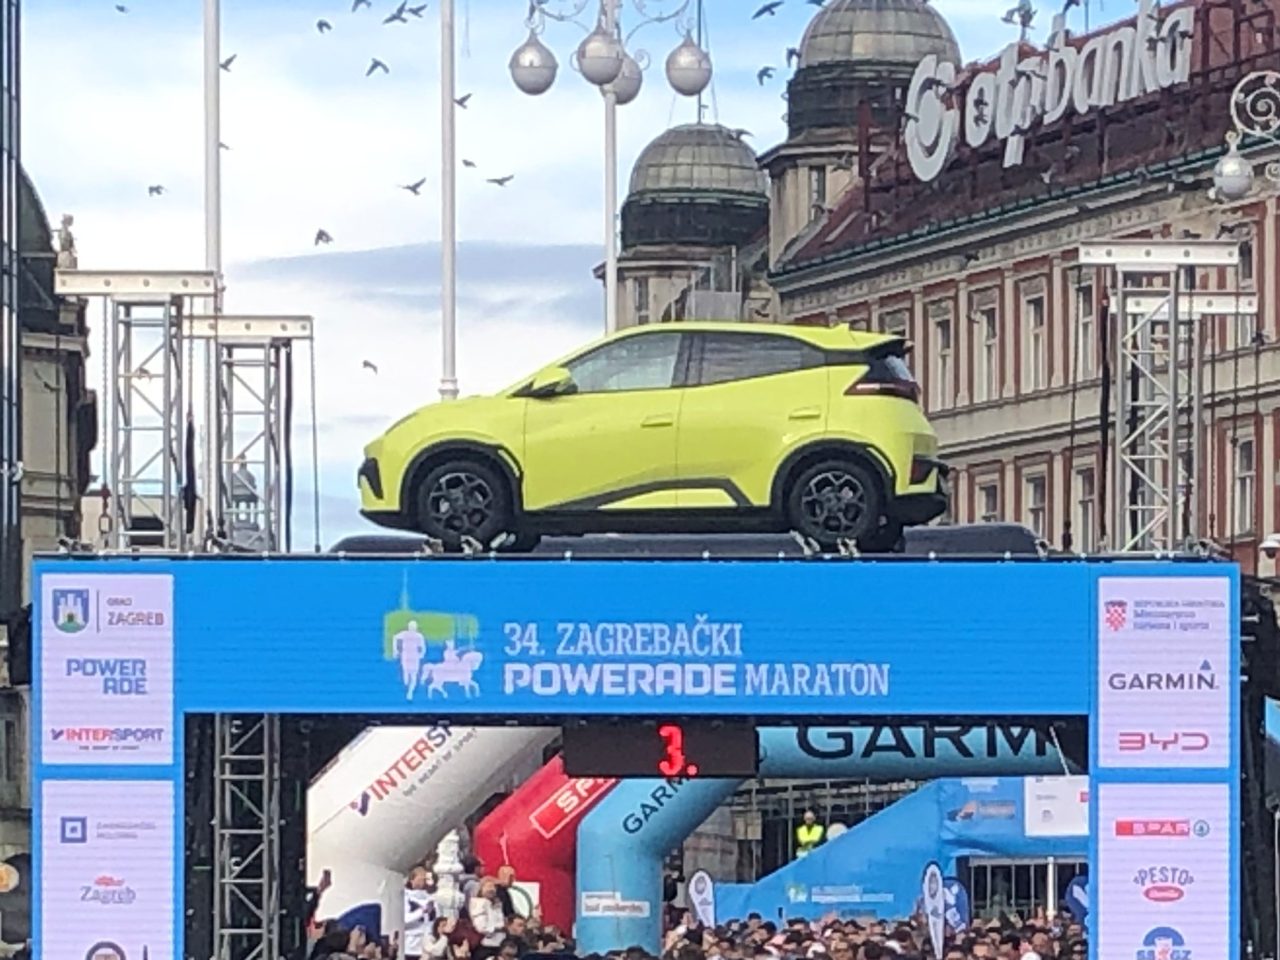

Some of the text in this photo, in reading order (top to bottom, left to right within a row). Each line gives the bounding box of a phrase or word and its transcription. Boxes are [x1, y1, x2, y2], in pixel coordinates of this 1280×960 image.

[107, 612, 165, 626] ZAGREB
[503, 613, 743, 656] 34. ZAGREBAČKI
[66, 658, 147, 676] POWER
[503, 662, 891, 697] POWERADE MARATON
[1108, 672, 1216, 690] GARMIN
[65, 727, 165, 741] INTERSPORT
[797, 725, 1048, 759] GARM
[1118, 732, 1209, 751] BYD
[369, 726, 453, 802] INTERS
[622, 777, 692, 836] GARM
[1132, 821, 1190, 836] SPAR
[1138, 866, 1190, 887] PESTO
